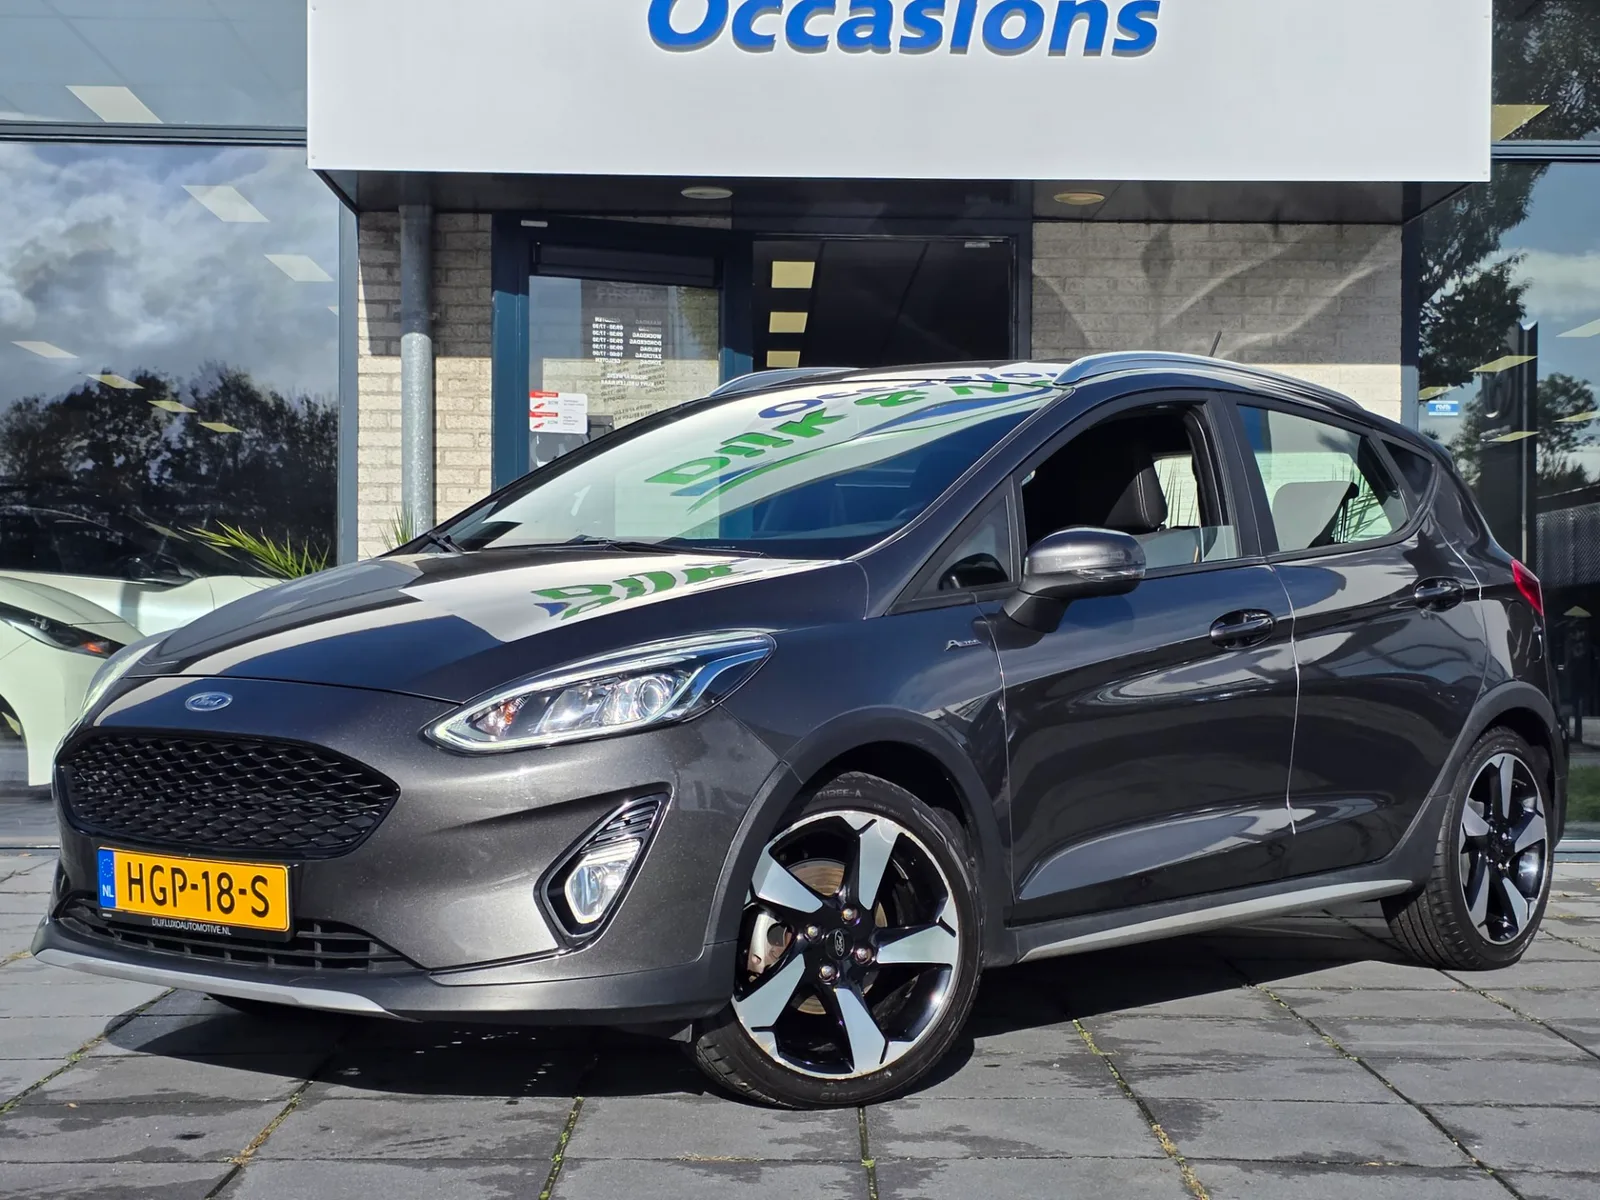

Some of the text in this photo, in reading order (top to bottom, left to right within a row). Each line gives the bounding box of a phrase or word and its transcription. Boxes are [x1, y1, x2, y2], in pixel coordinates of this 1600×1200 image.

[648, 0, 1160, 57] Occasions
[102, 885, 114, 898] NL
[127, 861, 270, 918] HGP-18-S
